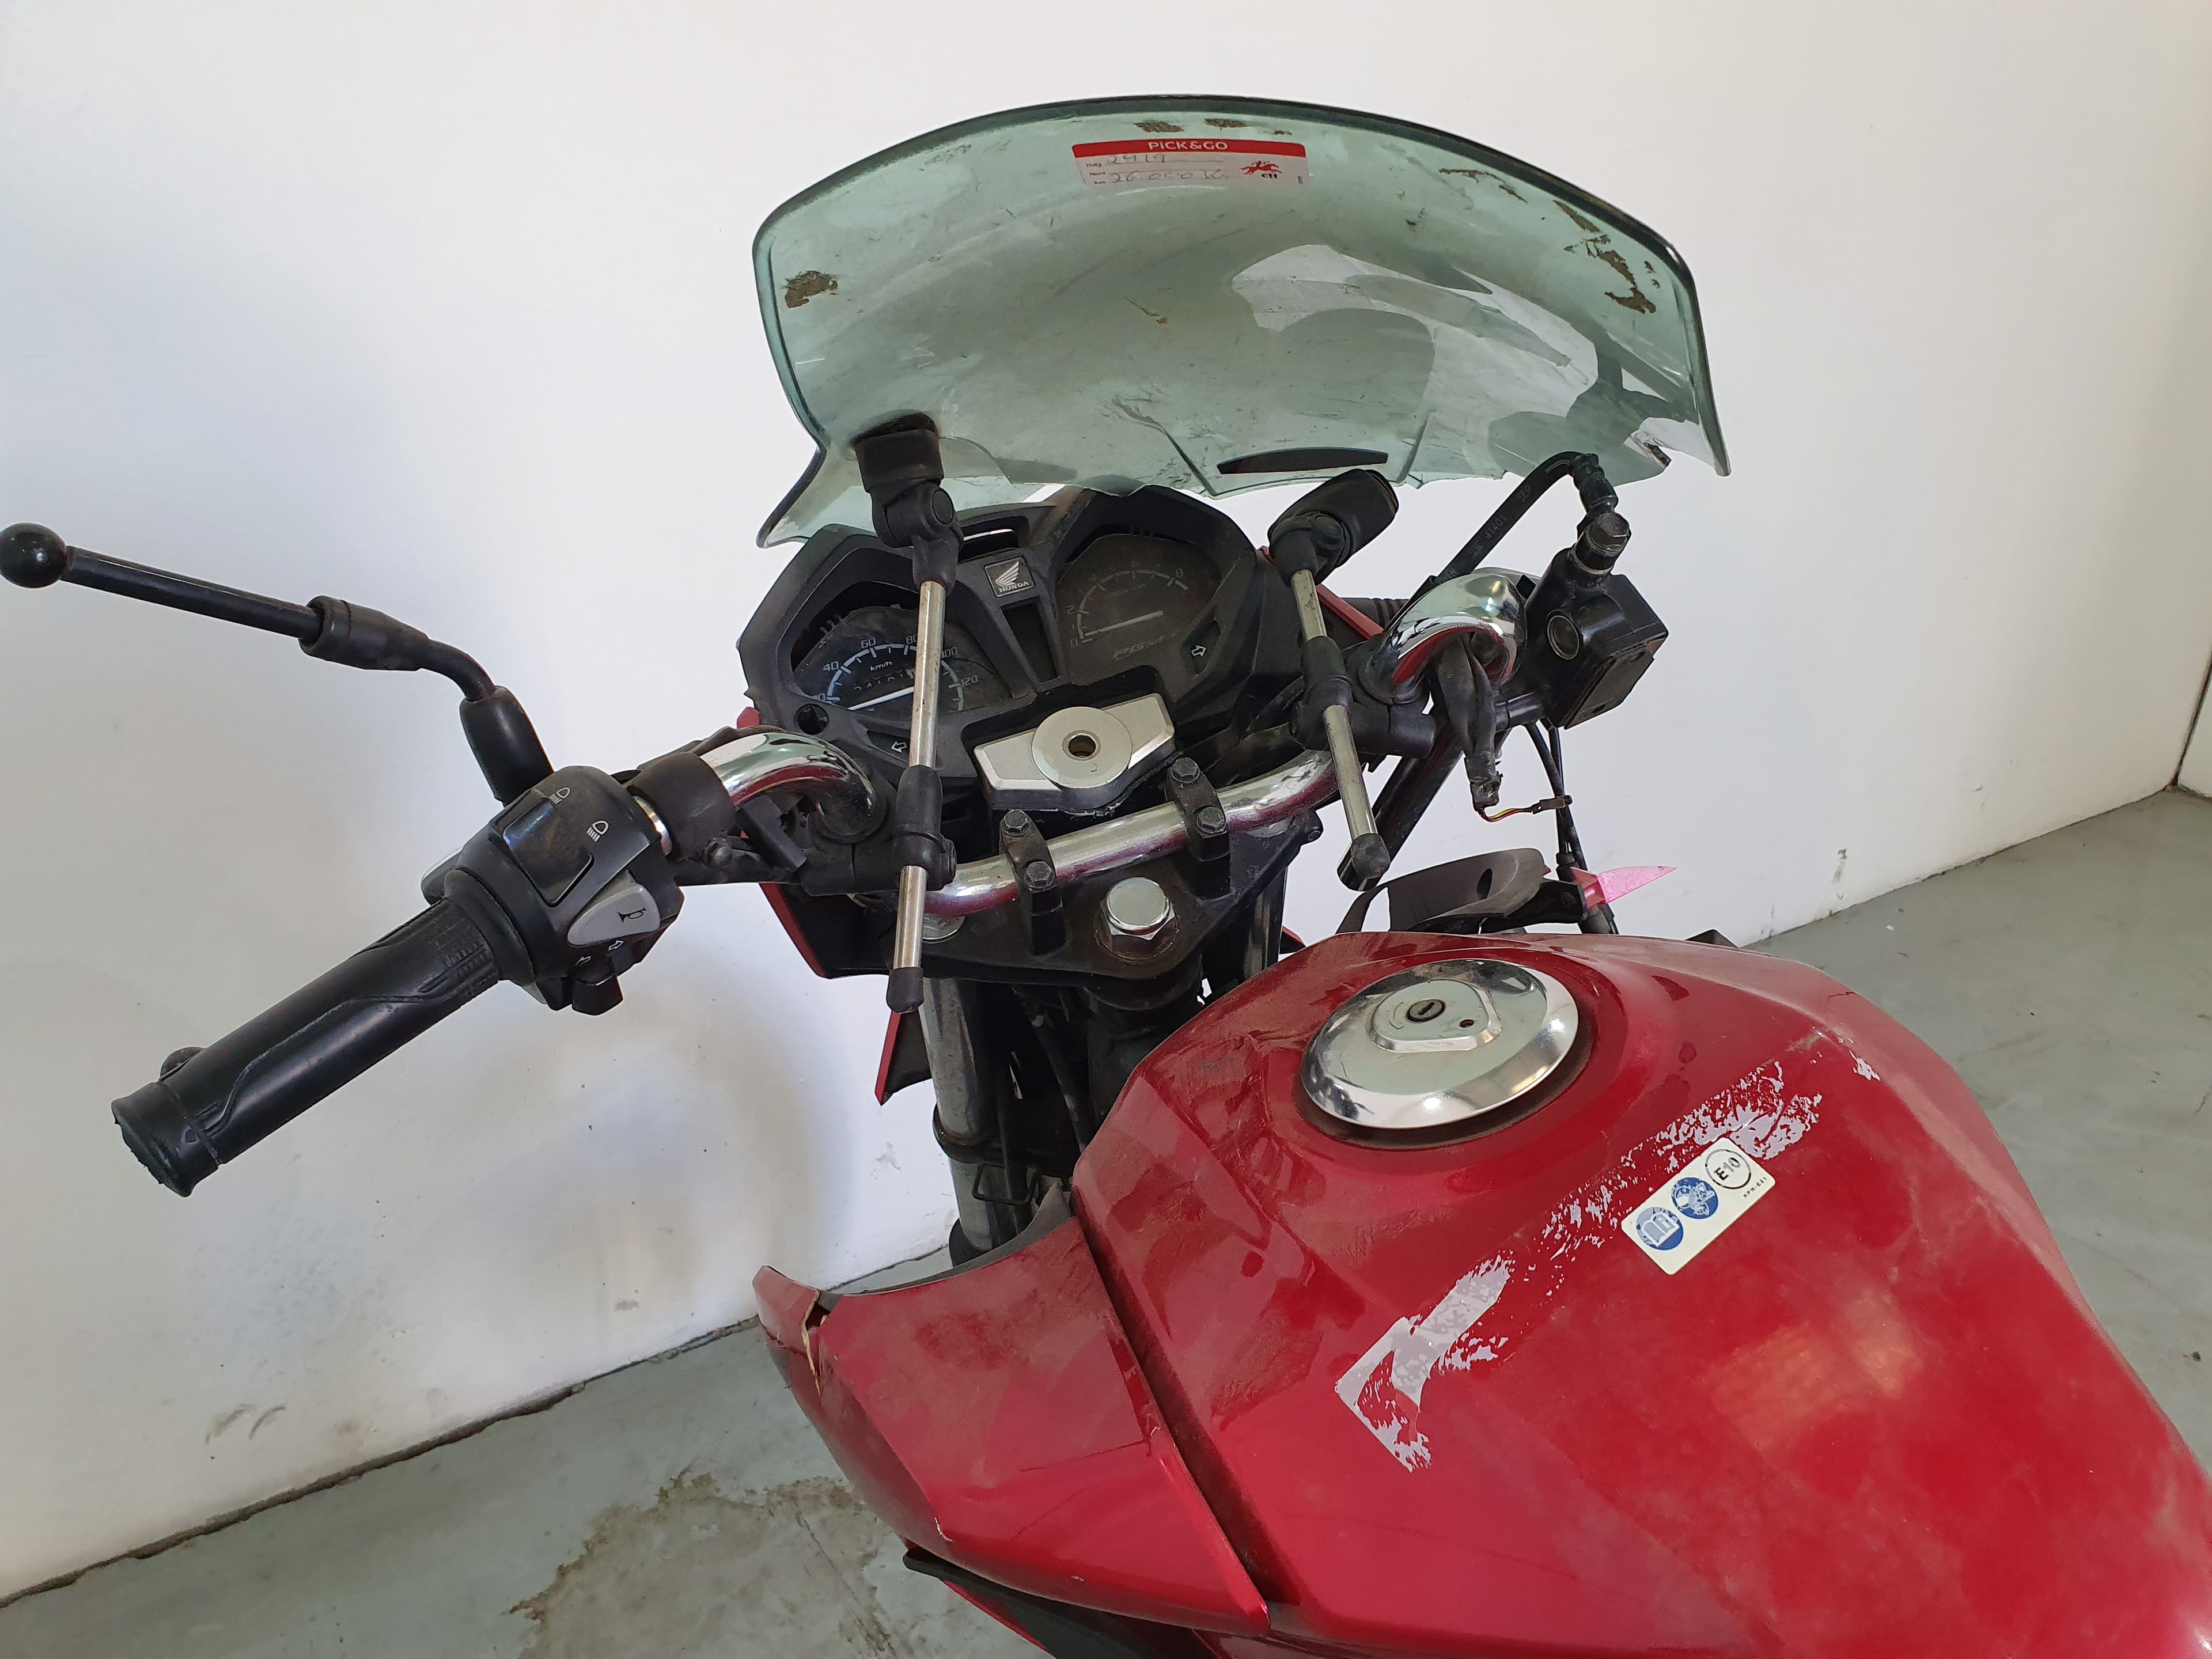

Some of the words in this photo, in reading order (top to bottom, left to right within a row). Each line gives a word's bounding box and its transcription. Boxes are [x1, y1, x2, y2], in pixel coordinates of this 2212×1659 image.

[1147, 141, 1228, 151] PICK&GO
[998, 581, 1029, 593] HONDA
[860, 637, 876, 647] 60
[823, 661, 839, 672] 40
[870, 661, 893, 672] km/h
[962, 675, 978, 686] 120
[1713, 1157, 1741, 1181] E10
